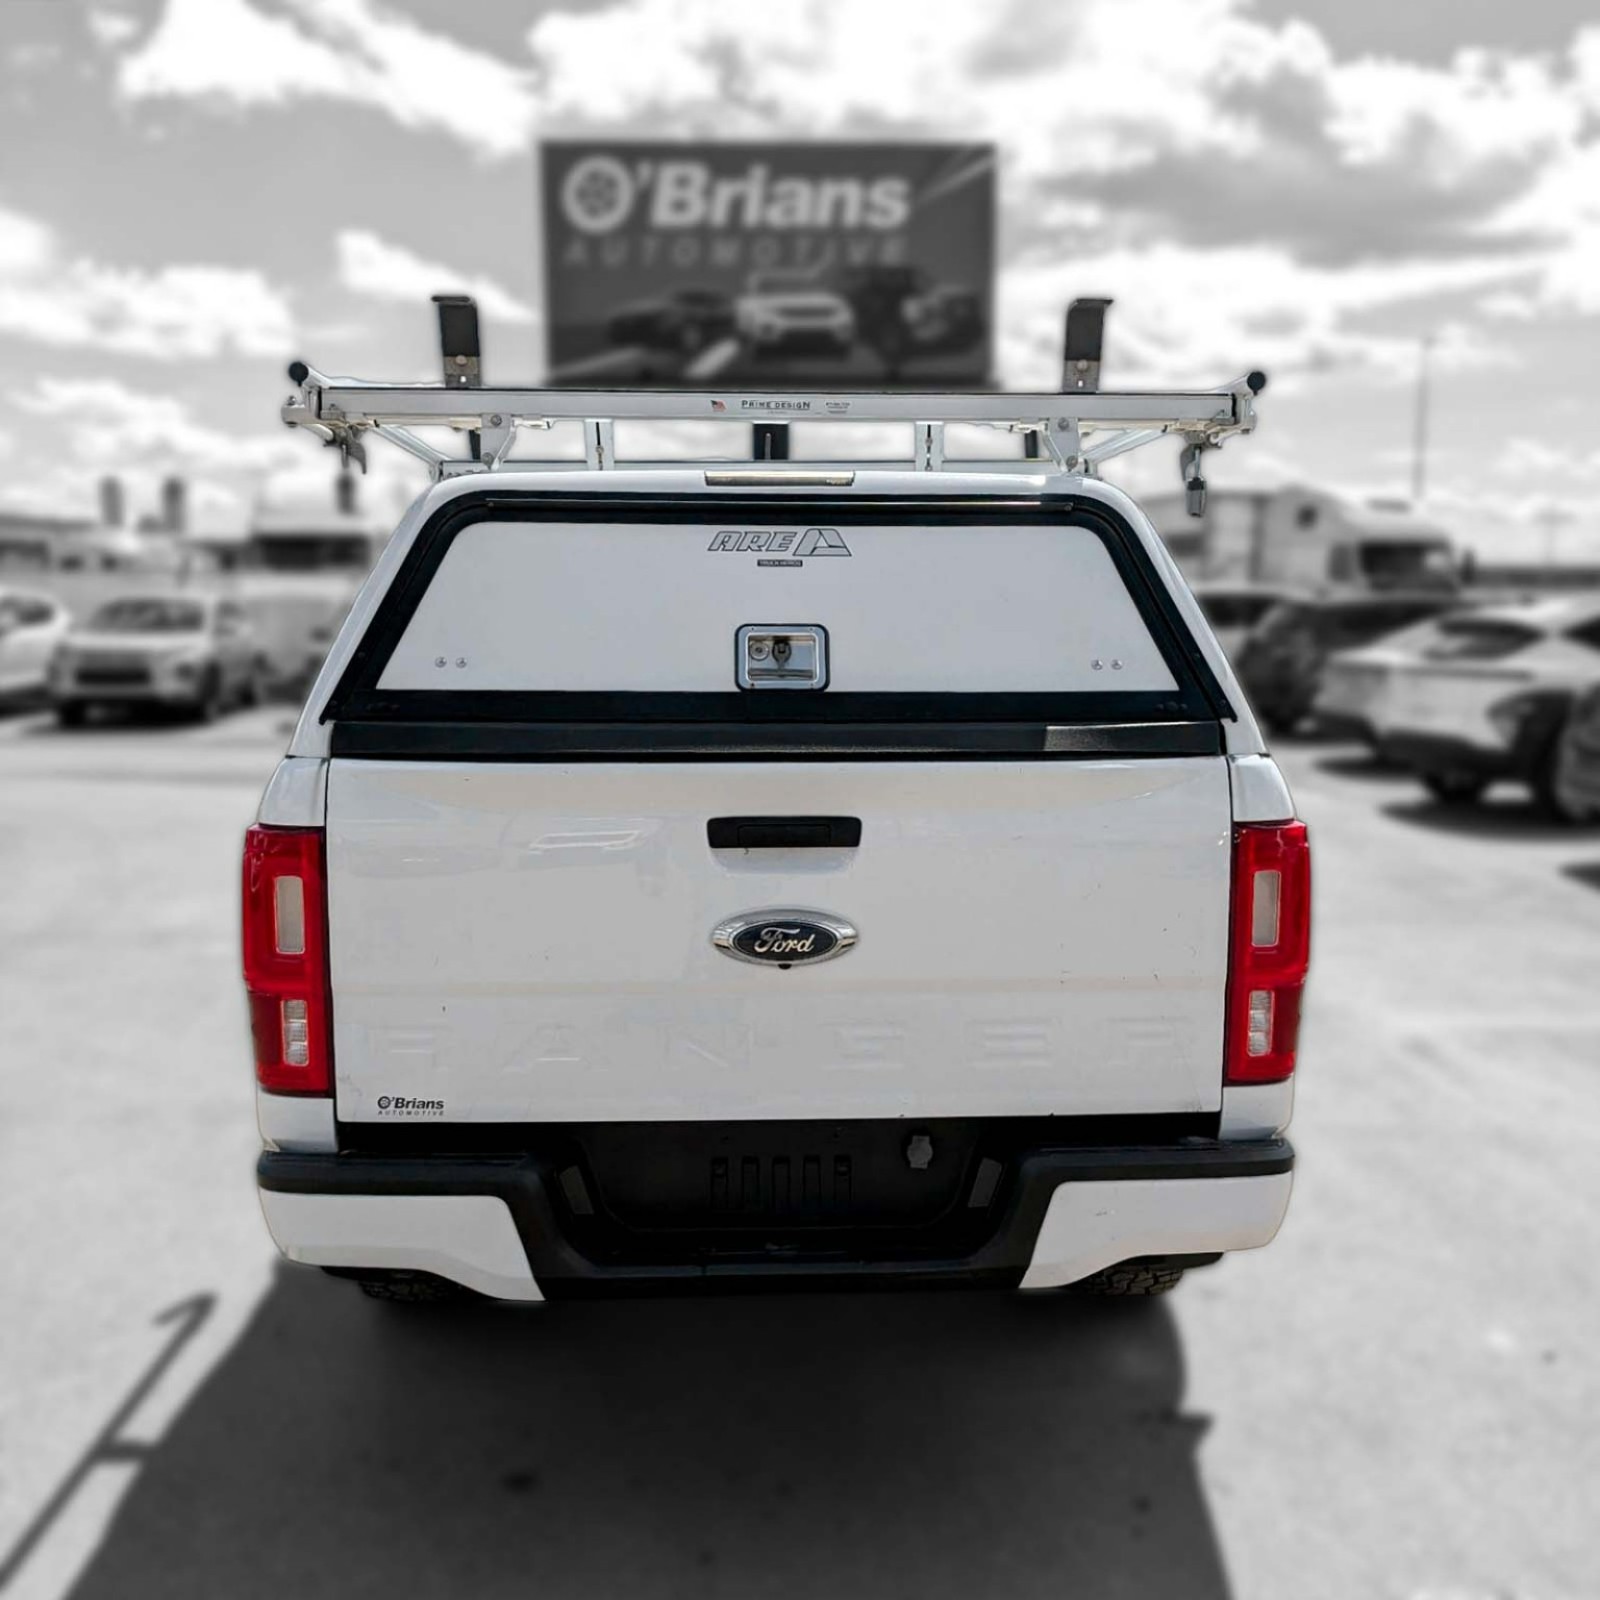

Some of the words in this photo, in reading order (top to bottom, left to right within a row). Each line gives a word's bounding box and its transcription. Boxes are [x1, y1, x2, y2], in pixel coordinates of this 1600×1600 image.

[562, 155, 910, 234] O'Brians
[564, 236, 907, 266] AUTOMOTIVE
[741, 399, 771, 408] PRIME
[775, 400, 810, 409] DESIGN
[754, 926, 816, 953] Ford
[377, 1095, 445, 1110] O'Brians
[377, 1109, 445, 1117] AUTOMOTIVE
